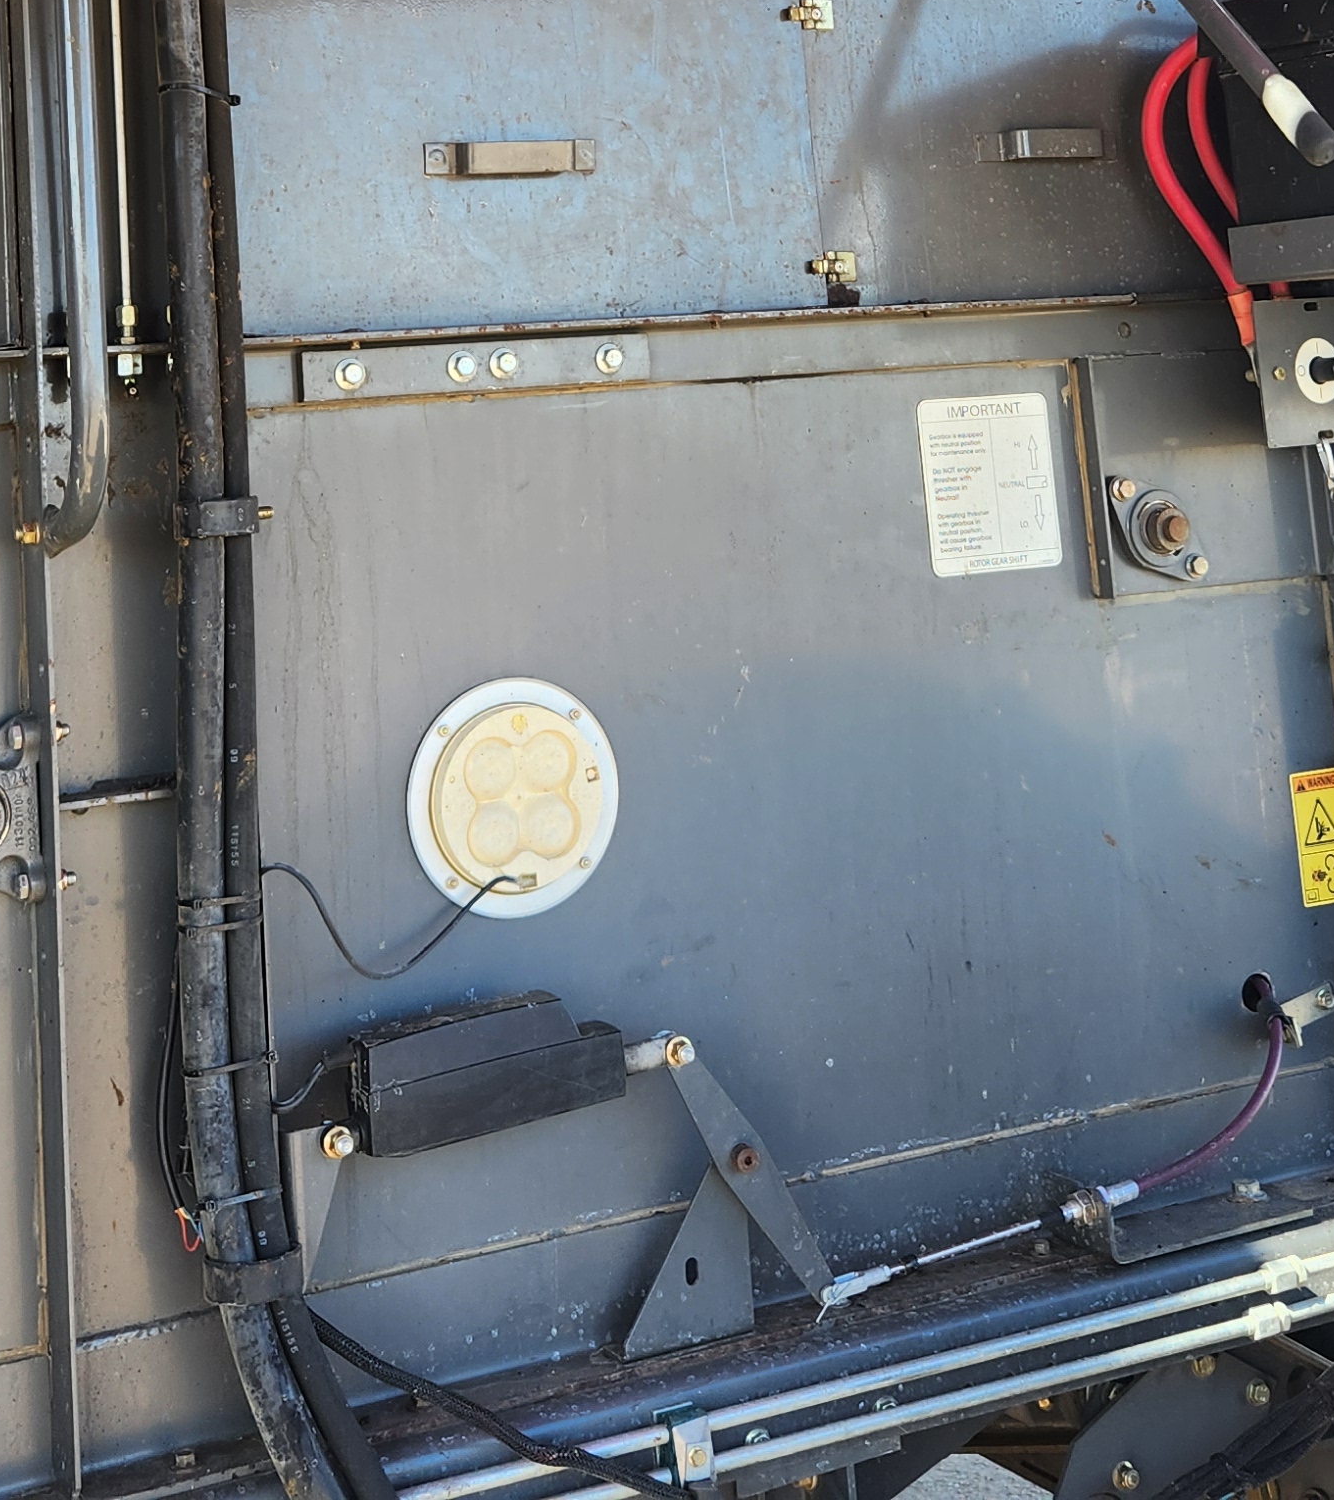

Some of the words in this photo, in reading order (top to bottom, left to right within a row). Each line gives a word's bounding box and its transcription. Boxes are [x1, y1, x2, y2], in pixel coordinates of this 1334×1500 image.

[947, 402, 1021, 418] IMPORTANT
[935, 486, 960, 494] gearbox
[937, 512, 965, 520] Operating
[950, 520, 974, 528] gearbox
[968, 535, 992, 543] gearbox
[969, 558, 990, 567] ROTOR
[991, 556, 1008, 565] GEAR
[1009, 554, 1028, 564] SHIFT
